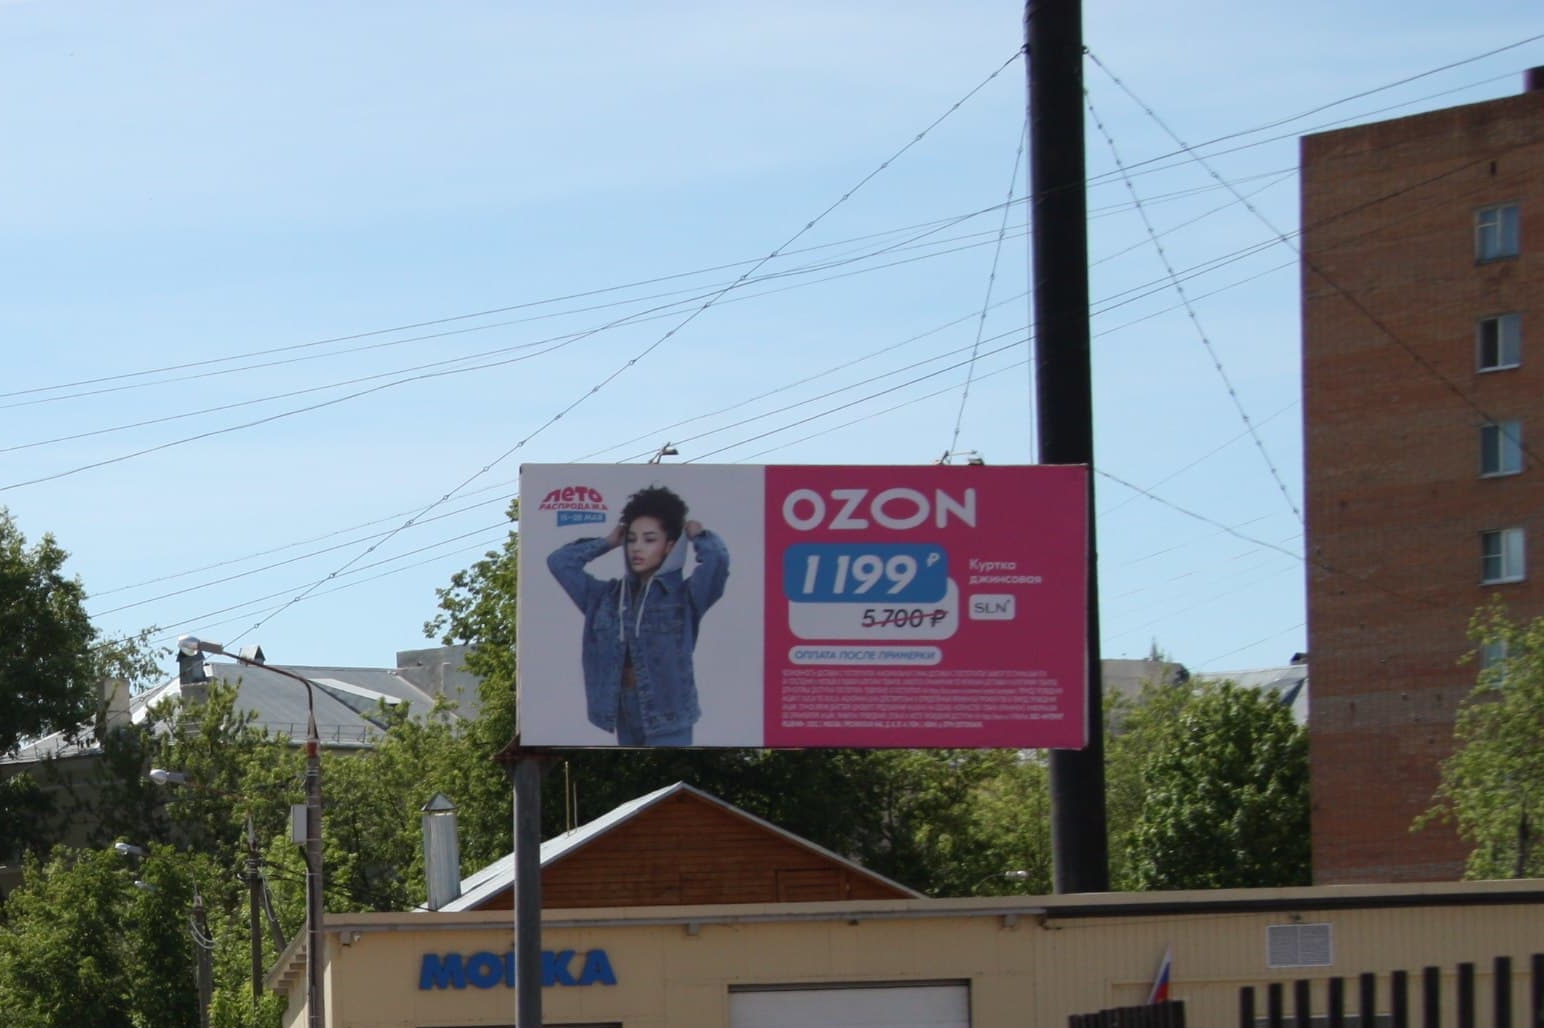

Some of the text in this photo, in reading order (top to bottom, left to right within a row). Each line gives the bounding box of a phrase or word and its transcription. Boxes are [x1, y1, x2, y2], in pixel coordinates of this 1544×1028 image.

[782, 488, 976, 531] OZON
[968, 558, 1016, 573] Куртка
[968, 575, 1043, 585] джинсовая
[794, 650, 936, 661] ОПЛАТА ПОСЛЕ ПРИМЕРКИ
[419, 949, 617, 990] МОКА
